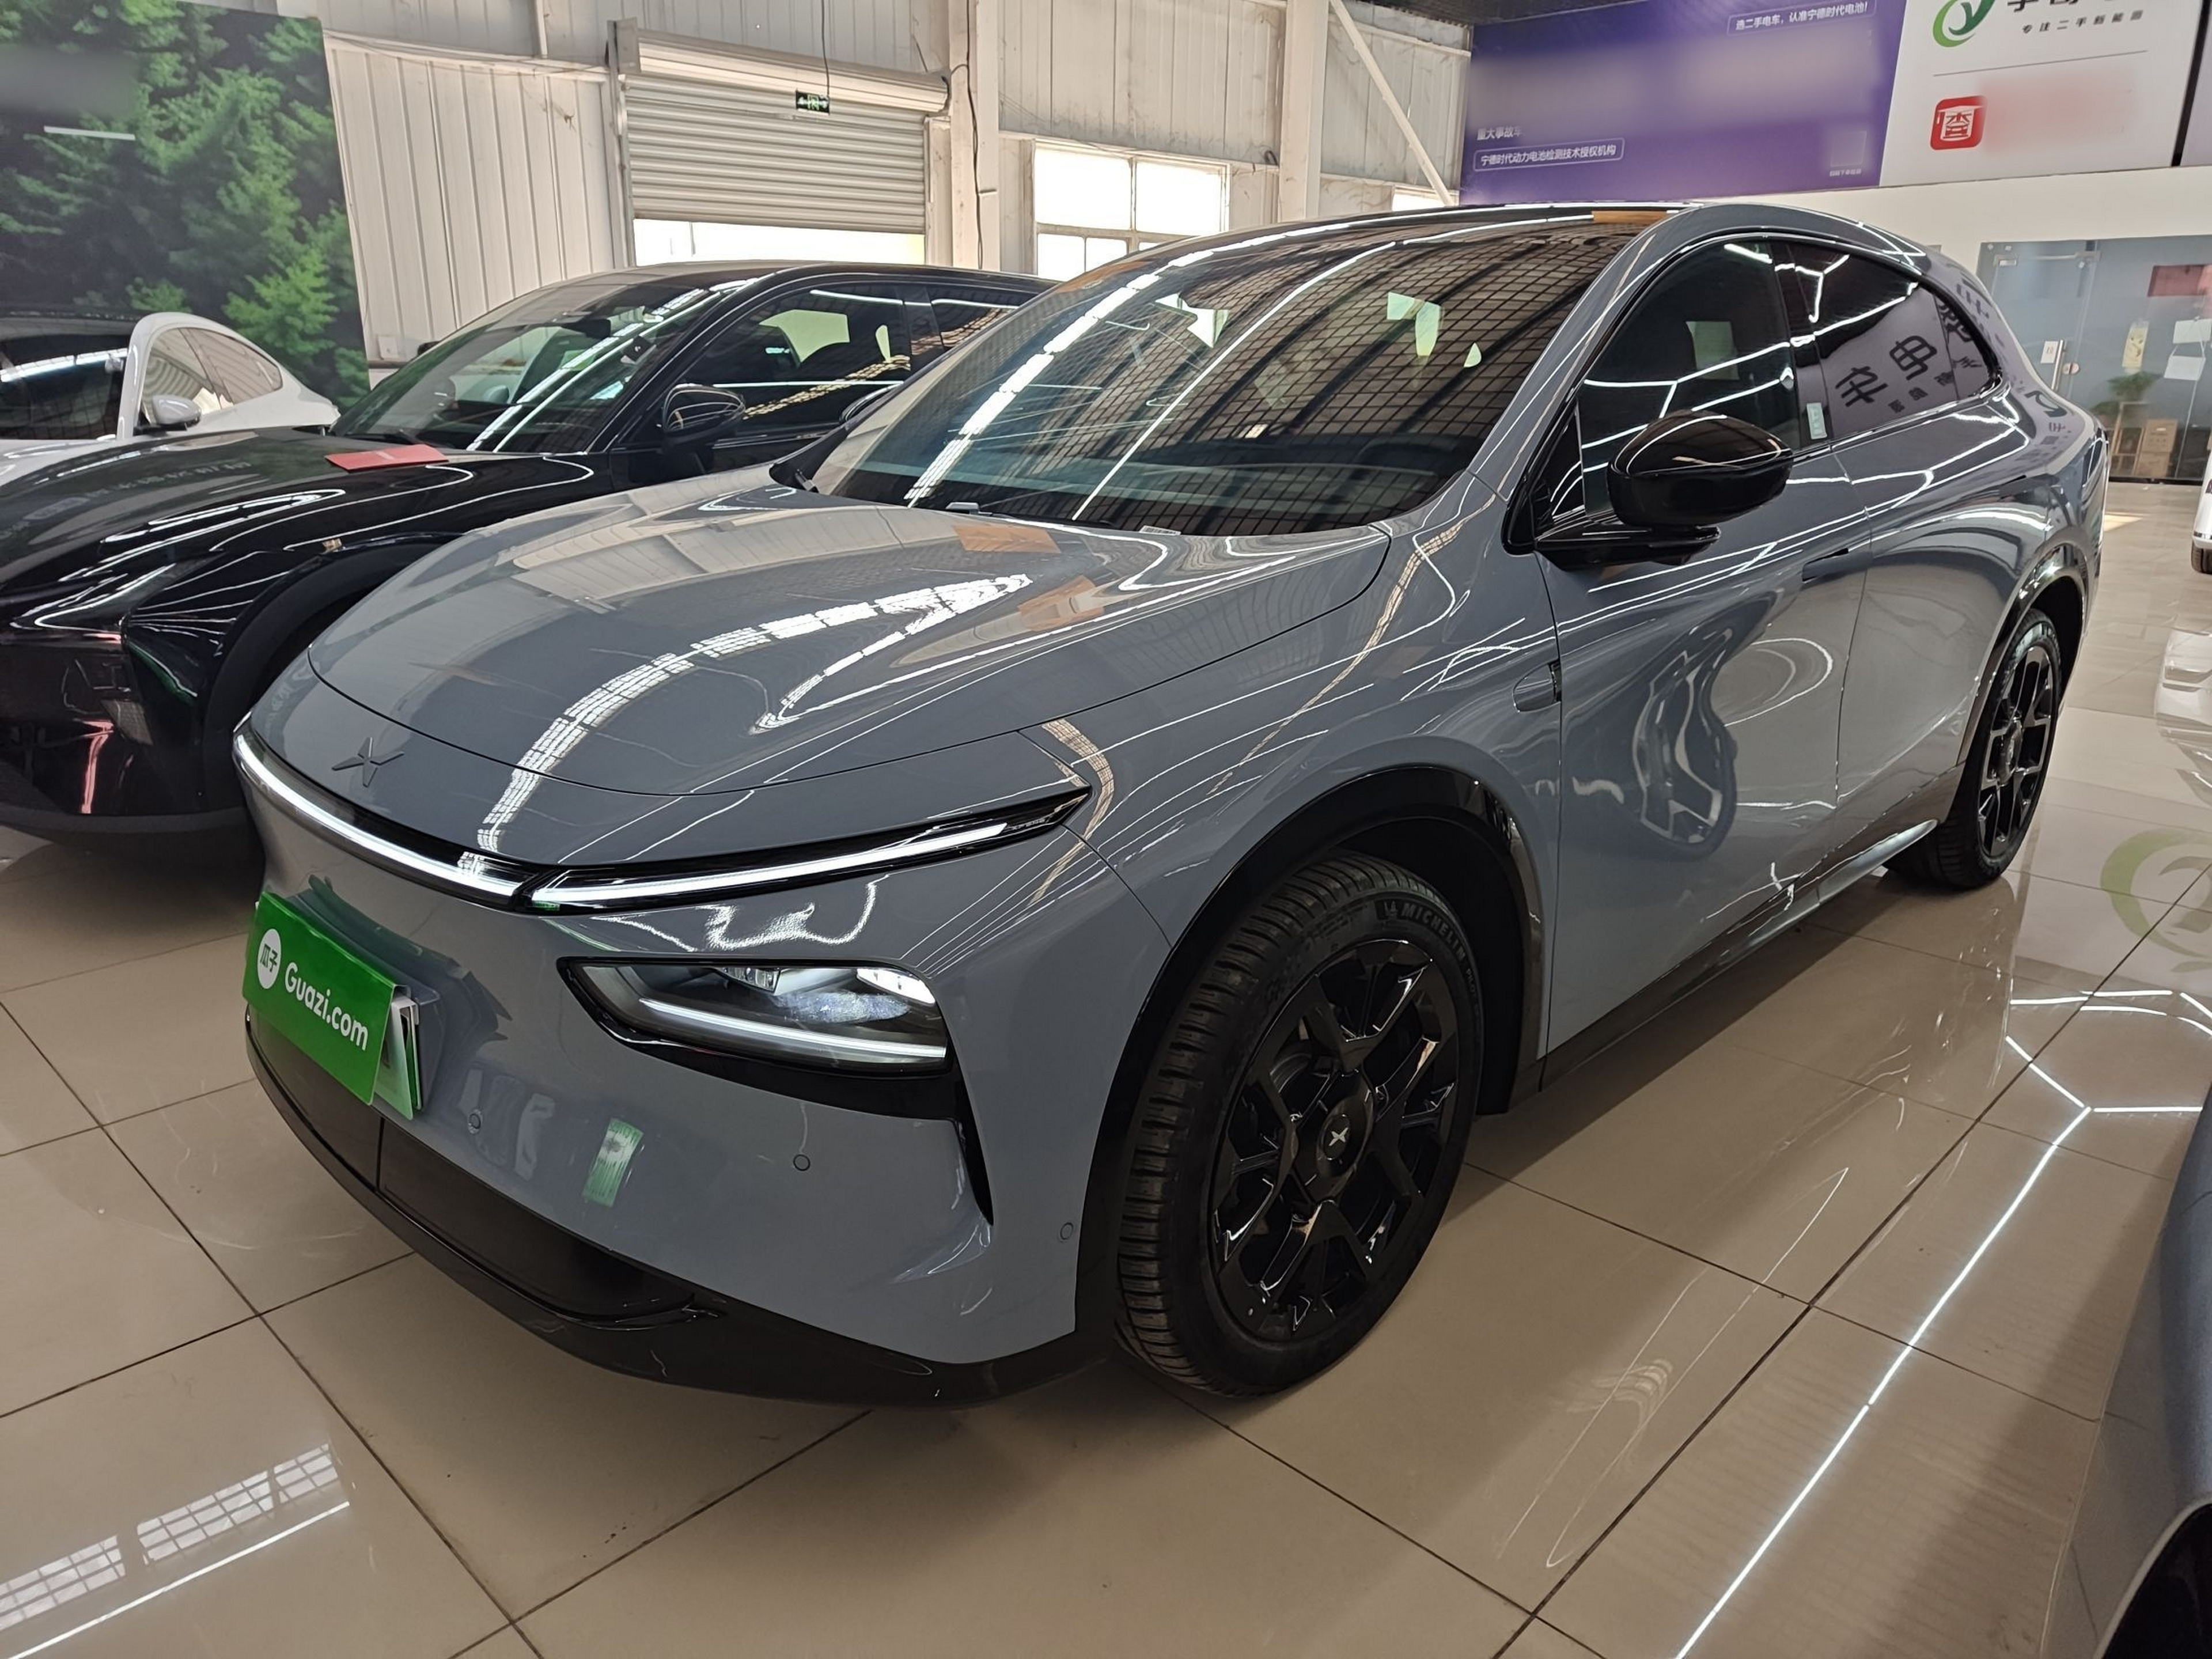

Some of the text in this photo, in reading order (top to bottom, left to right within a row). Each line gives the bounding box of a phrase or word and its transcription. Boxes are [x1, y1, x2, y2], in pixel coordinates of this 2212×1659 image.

[260, 944, 278, 973] 瓜子
[1401, 903, 1466, 960] MICHELIN
[285, 962, 369, 1051] Guazi.com
